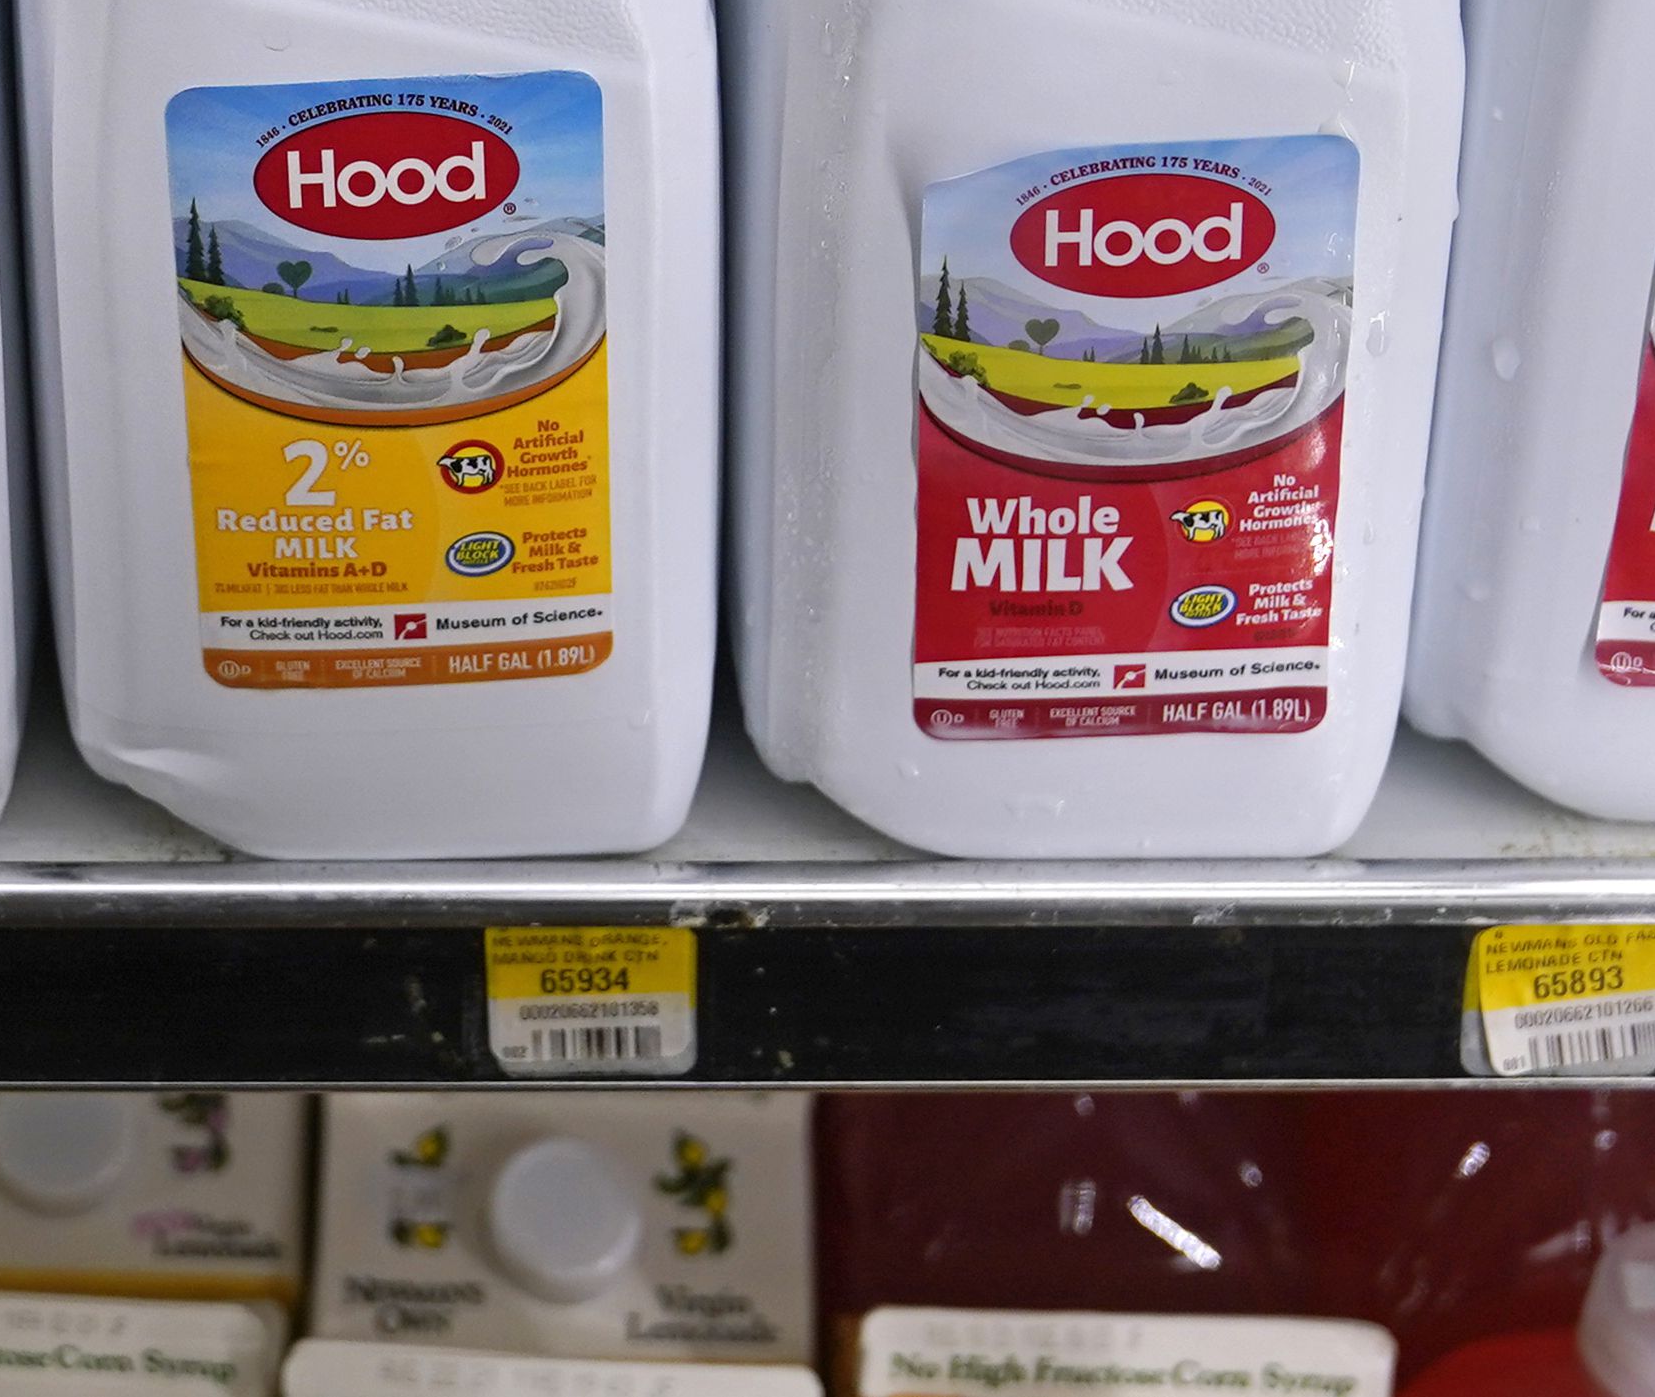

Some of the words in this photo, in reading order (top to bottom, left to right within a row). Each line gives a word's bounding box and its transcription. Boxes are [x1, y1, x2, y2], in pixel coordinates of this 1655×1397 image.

[256, 127, 280, 147] 1846
[289, 94, 393, 126] CELEBRATING
[397, 94, 425, 106] 175
[430, 96, 478, 116] YEARS
[486, 115, 513, 135] 2021
[287, 141, 486, 209] Hood
[1050, 156, 1156, 186] CELEBRATING
[1161, 156, 1189, 168] 175
[1193, 158, 1240, 179] YEARS
[1044, 203, 1243, 267] Hood
[537, 419, 560, 432] No
[513, 430, 583, 449] Artificial
[520, 447, 578, 464] Growth
[283, 439, 370, 506] 2%
[217, 508, 355, 532] Reduced
[362, 508, 414, 530] Fat
[965, 495, 1121, 536] Whole
[523, 527, 587, 543] Protects
[275, 537, 359, 559] MILK
[530, 543, 565, 557] Milk
[568, 542, 581, 553] &
[248, 563, 339, 578] Vitamins
[344, 562, 387, 577] A+D
[512, 559, 554, 573] Fresh
[557, 555, 599, 569] Taste
[950, 535, 1135, 593] MILK
[220, 617, 242, 627] For
[247, 619, 253, 627] a
[258, 617, 330, 628] kid-friendly
[334, 616, 382, 628] activity,
[436, 617, 505, 630] Museum
[512, 612, 529, 625] of
[250, 630, 290, 641] Check
[295, 630, 314, 641] out
[318, 630, 383, 640] Hood.com
[449, 654, 494, 673] HALF
[499, 651, 531, 670] GAL
[537, 644, 595, 669] (1.89L)
[1155, 667, 1223, 681] Museum
[1229, 663, 1247, 676] of
[1164, 703, 1209, 723] HALF
[1213, 701, 1245, 719] GAL
[1252, 694, 1308, 718] (1.89L)
[540, 967, 631, 994] 65934
[1533, 965, 1624, 1000] 65893
